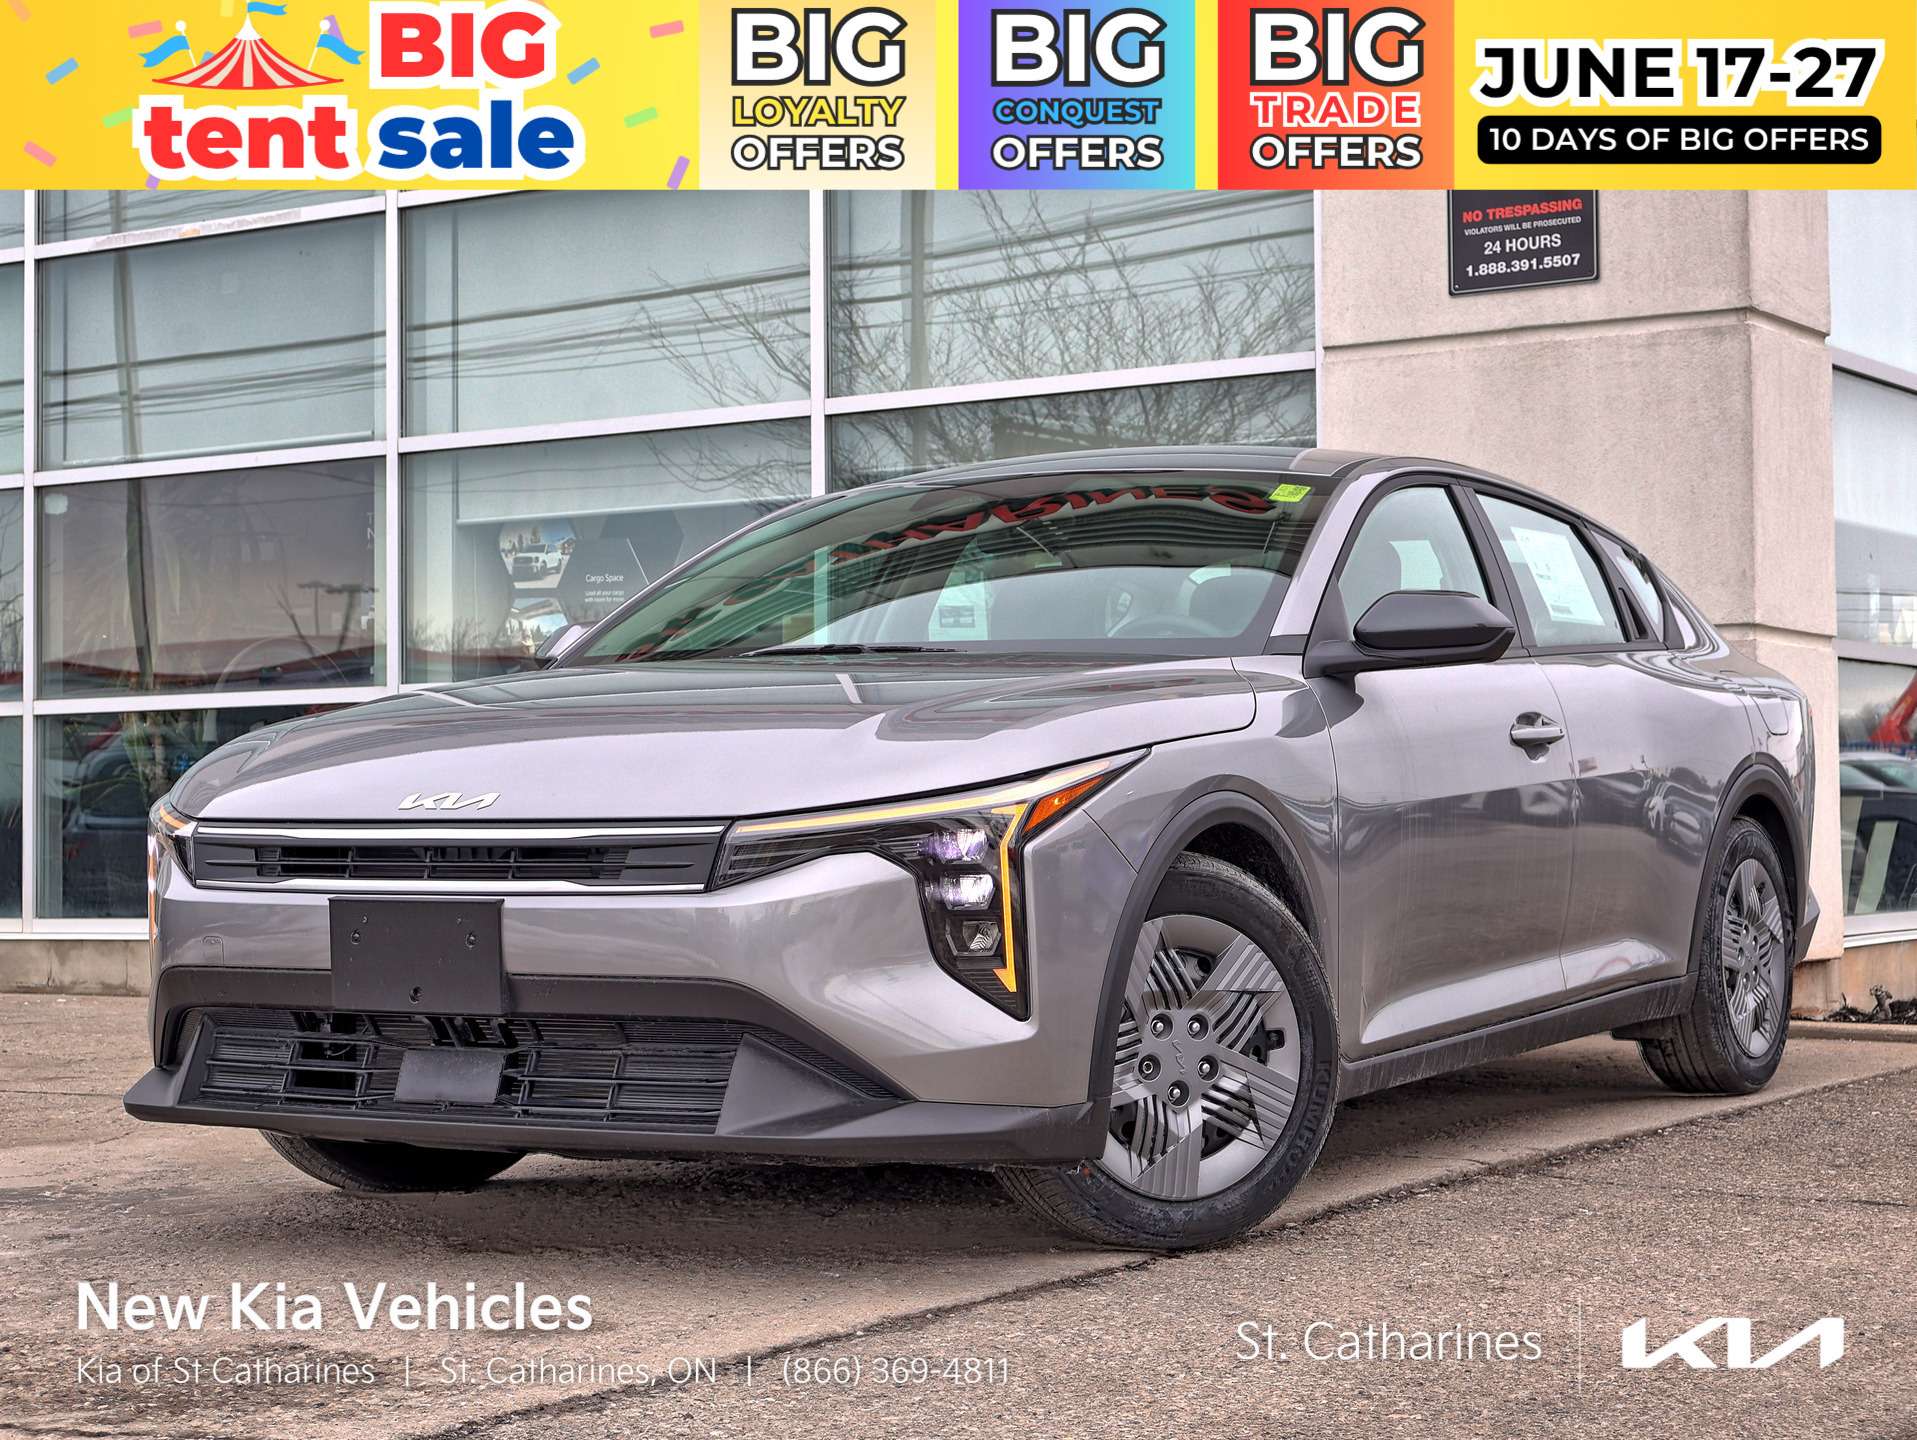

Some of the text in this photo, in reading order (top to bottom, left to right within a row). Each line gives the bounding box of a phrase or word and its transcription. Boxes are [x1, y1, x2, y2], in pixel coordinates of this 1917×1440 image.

[1462, 198, 1584, 224] NO TRESPASSING
[1464, 215, 1582, 237] VIOLATORS WILL BE PROSECUTED
[1484, 233, 1563, 256] 24 HOURS
[1466, 252, 1581, 278] 1.888.391.5507
[585, 573, 625, 585] Cargo Space
[398, 791, 501, 811] KIA
